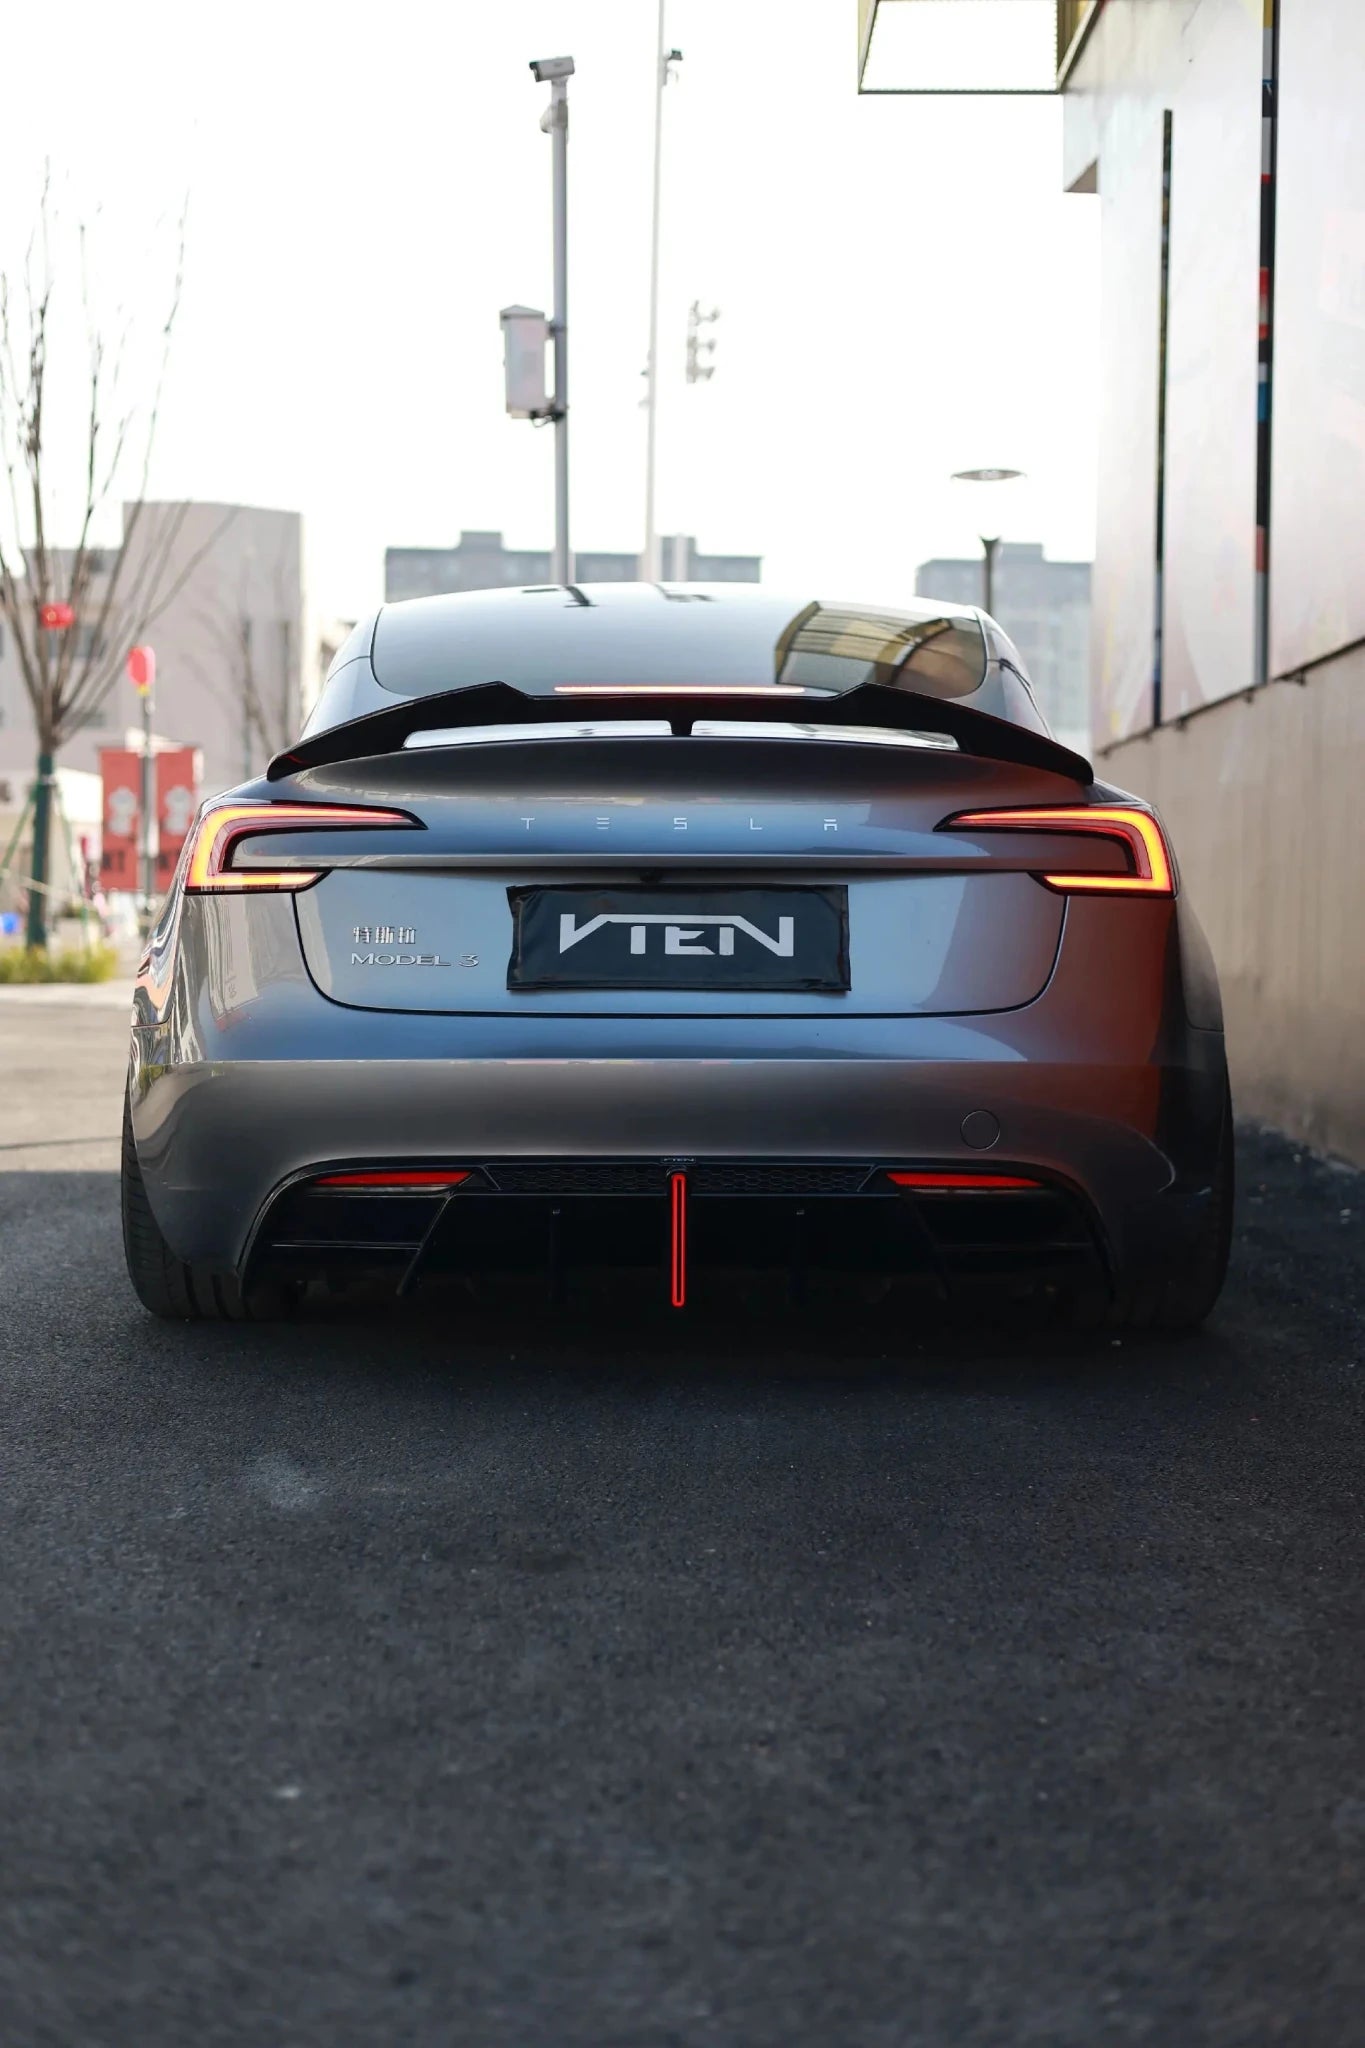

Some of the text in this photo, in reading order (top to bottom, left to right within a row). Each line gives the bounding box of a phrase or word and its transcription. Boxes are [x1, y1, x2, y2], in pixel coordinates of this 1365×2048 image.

[520, 817, 838, 831] TESLA
[352, 926, 416, 944] 特斯拉
[559, 913, 795, 957] VTEN
[351, 952, 480, 967] MODEL 3
